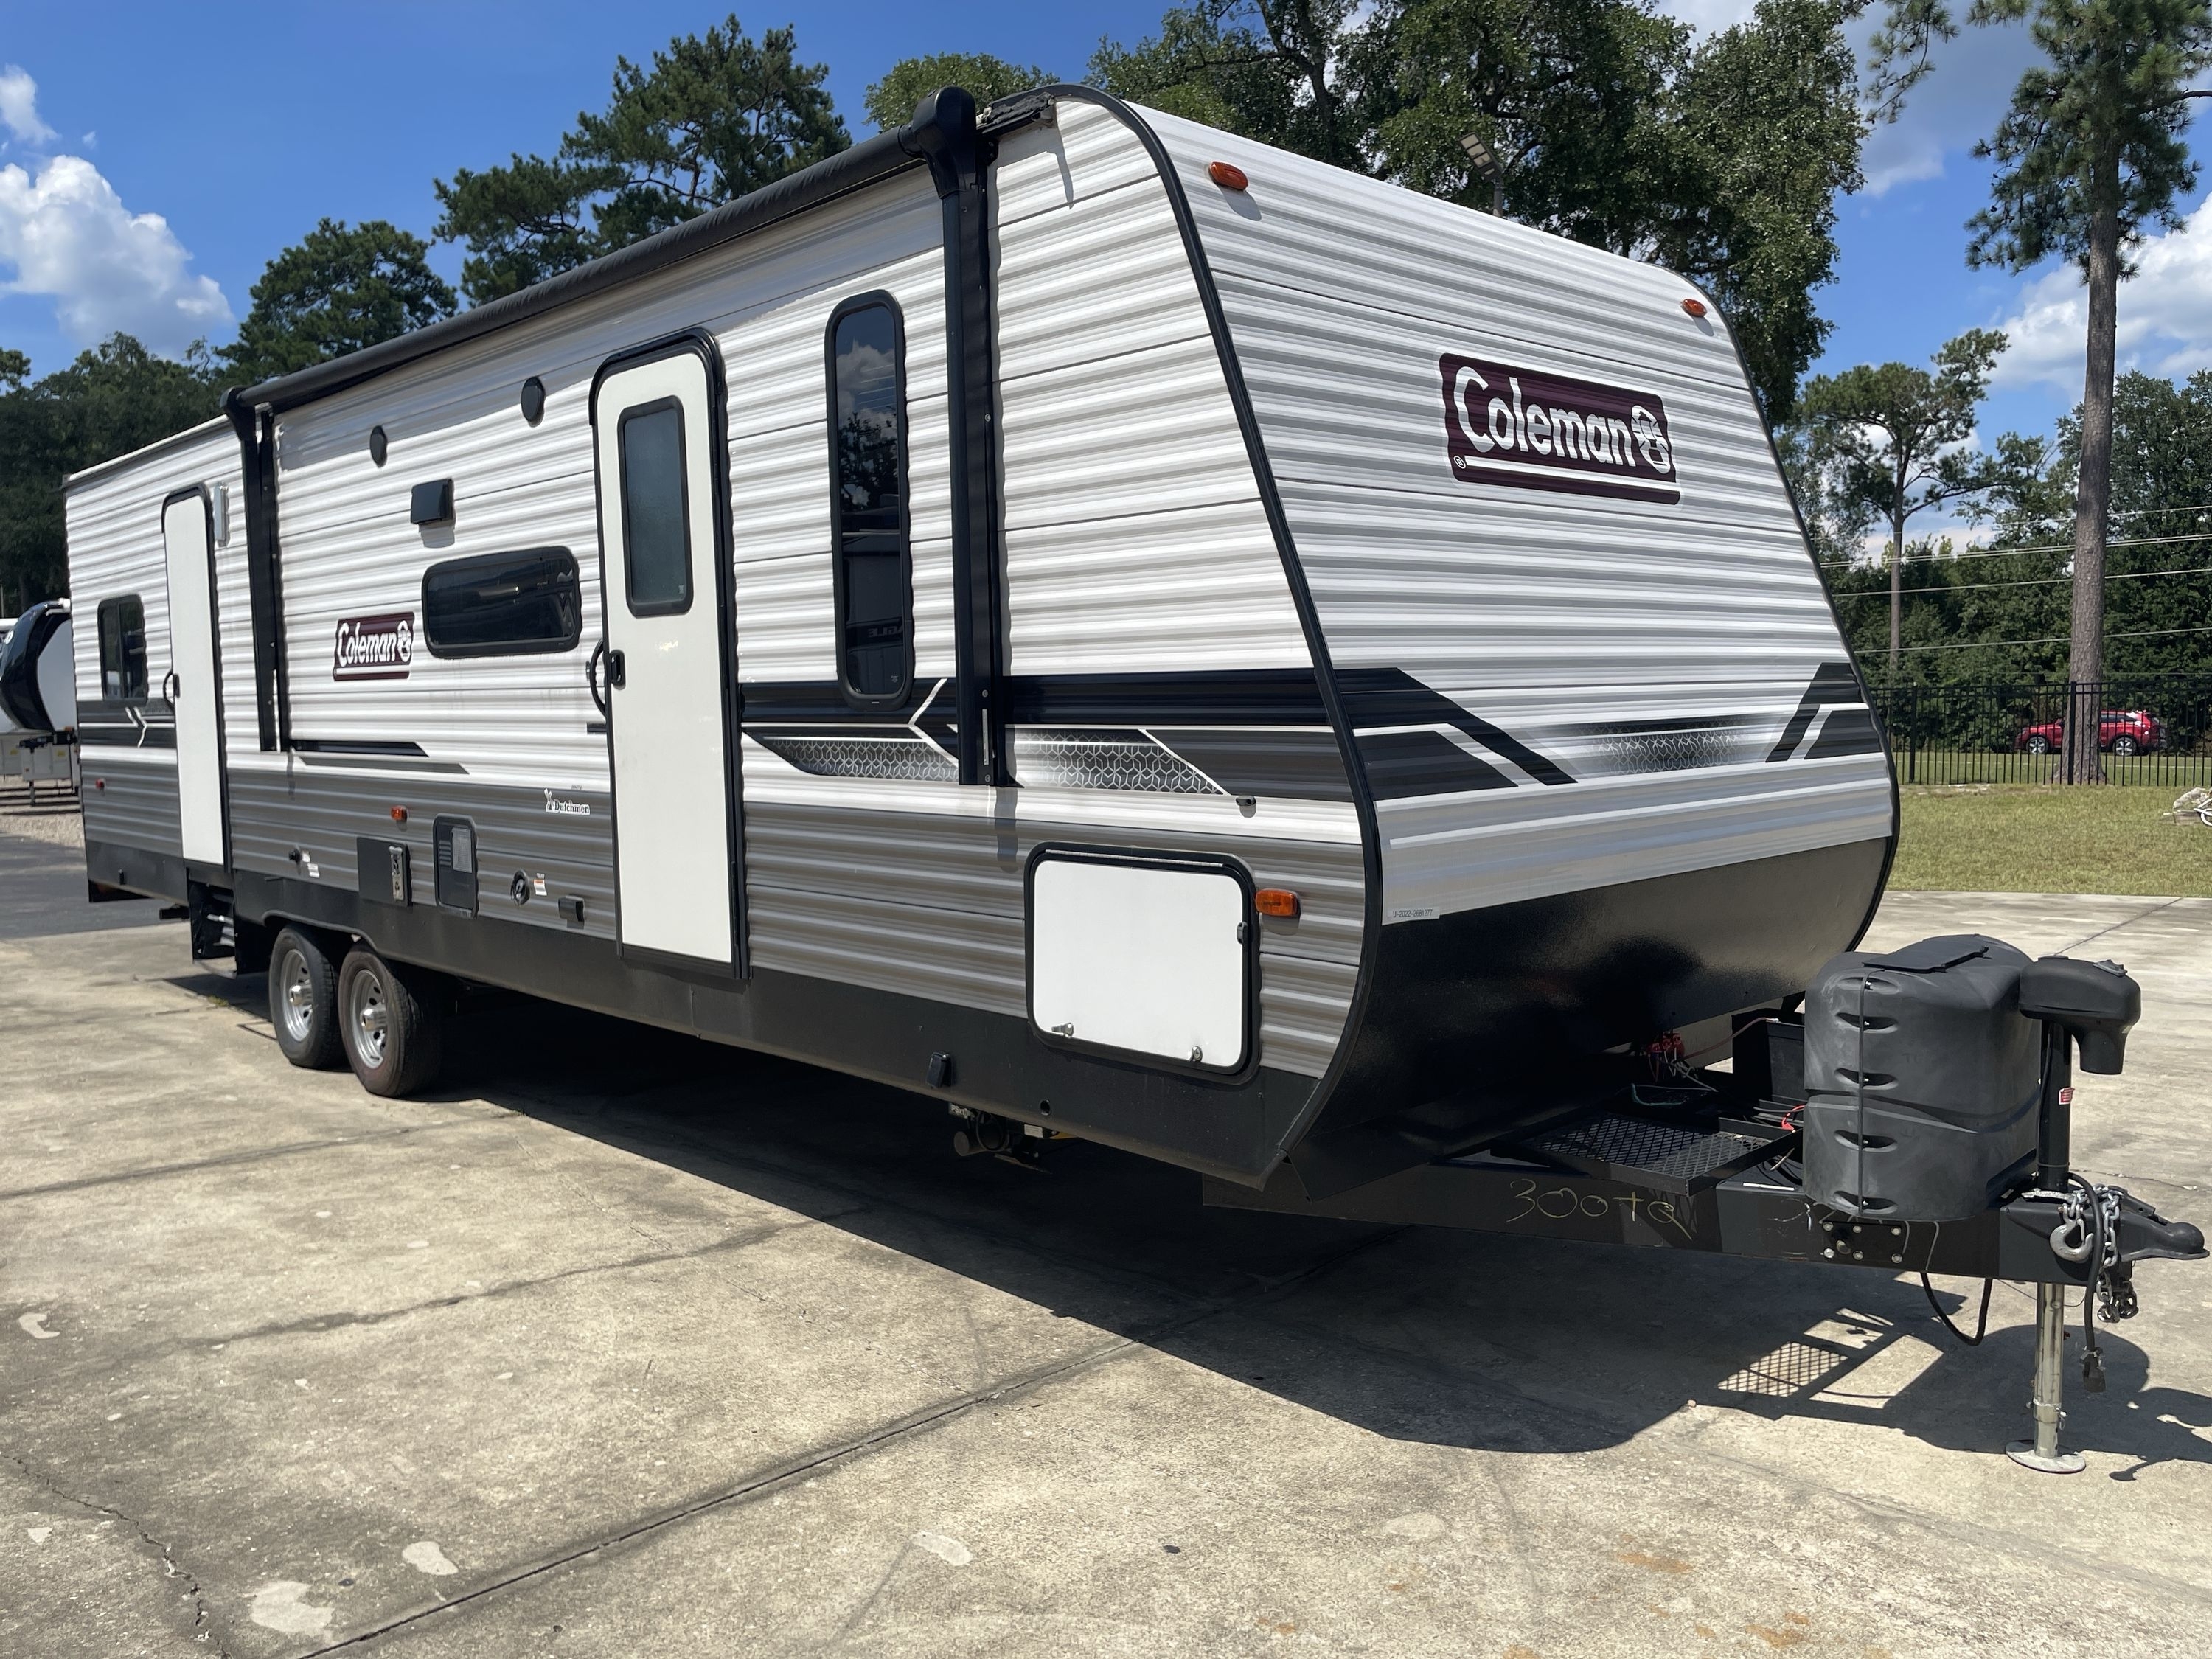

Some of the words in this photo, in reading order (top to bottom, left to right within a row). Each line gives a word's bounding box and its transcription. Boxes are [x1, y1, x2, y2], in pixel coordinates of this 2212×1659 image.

[1453, 366, 1636, 467] Coleman
[337, 620, 396, 667] Coleman
[554, 799, 590, 813] Dutchmen
